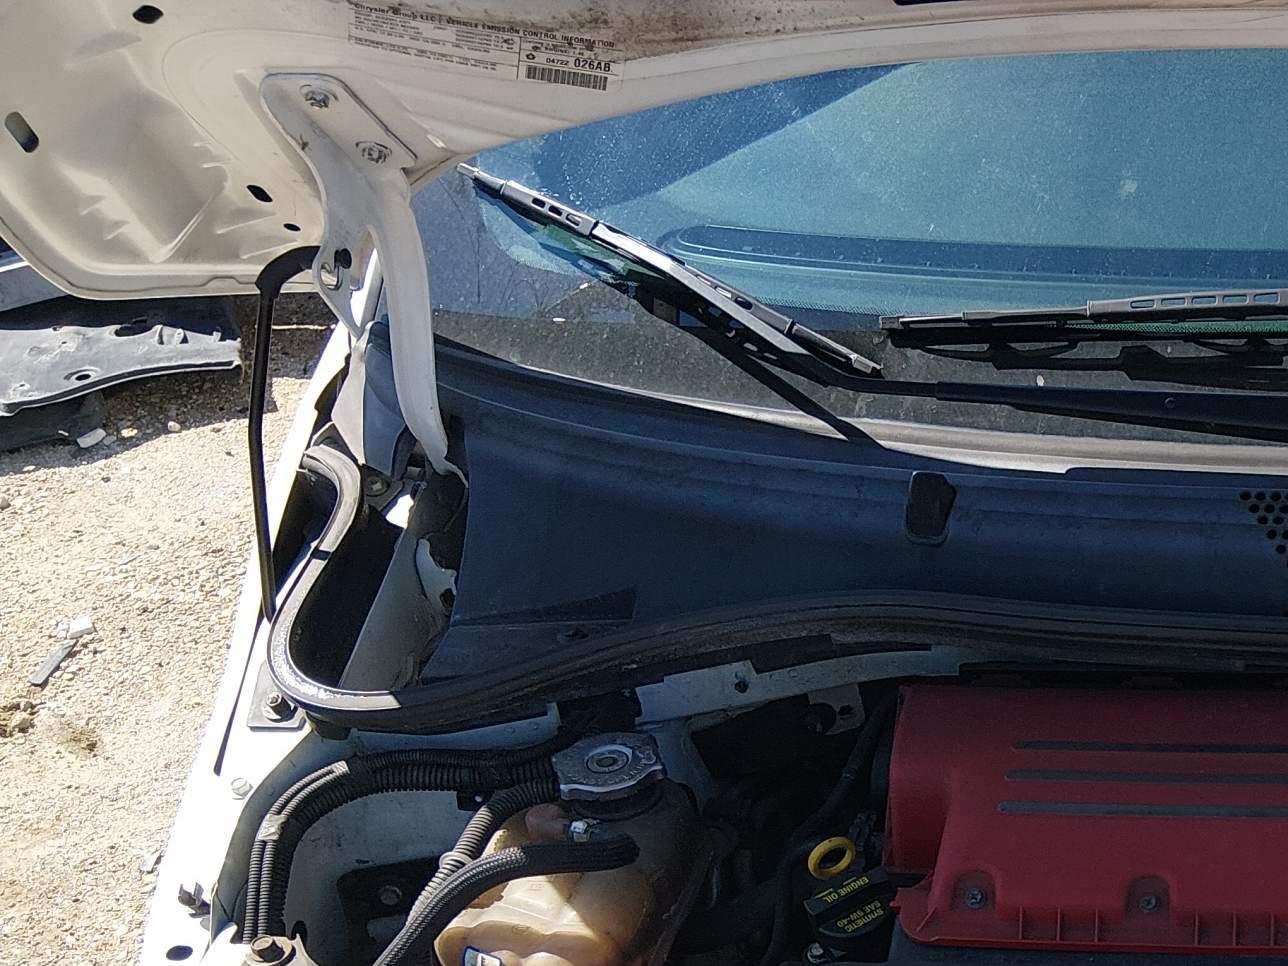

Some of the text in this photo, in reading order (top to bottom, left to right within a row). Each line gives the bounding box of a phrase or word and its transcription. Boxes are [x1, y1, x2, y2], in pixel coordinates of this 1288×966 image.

[481, 23, 521, 35] EMISSION
[523, 29, 559, 41] CONTROL
[561, 34, 615, 49] INFORMATION
[823, 876, 869, 903] ENGINE OIL
